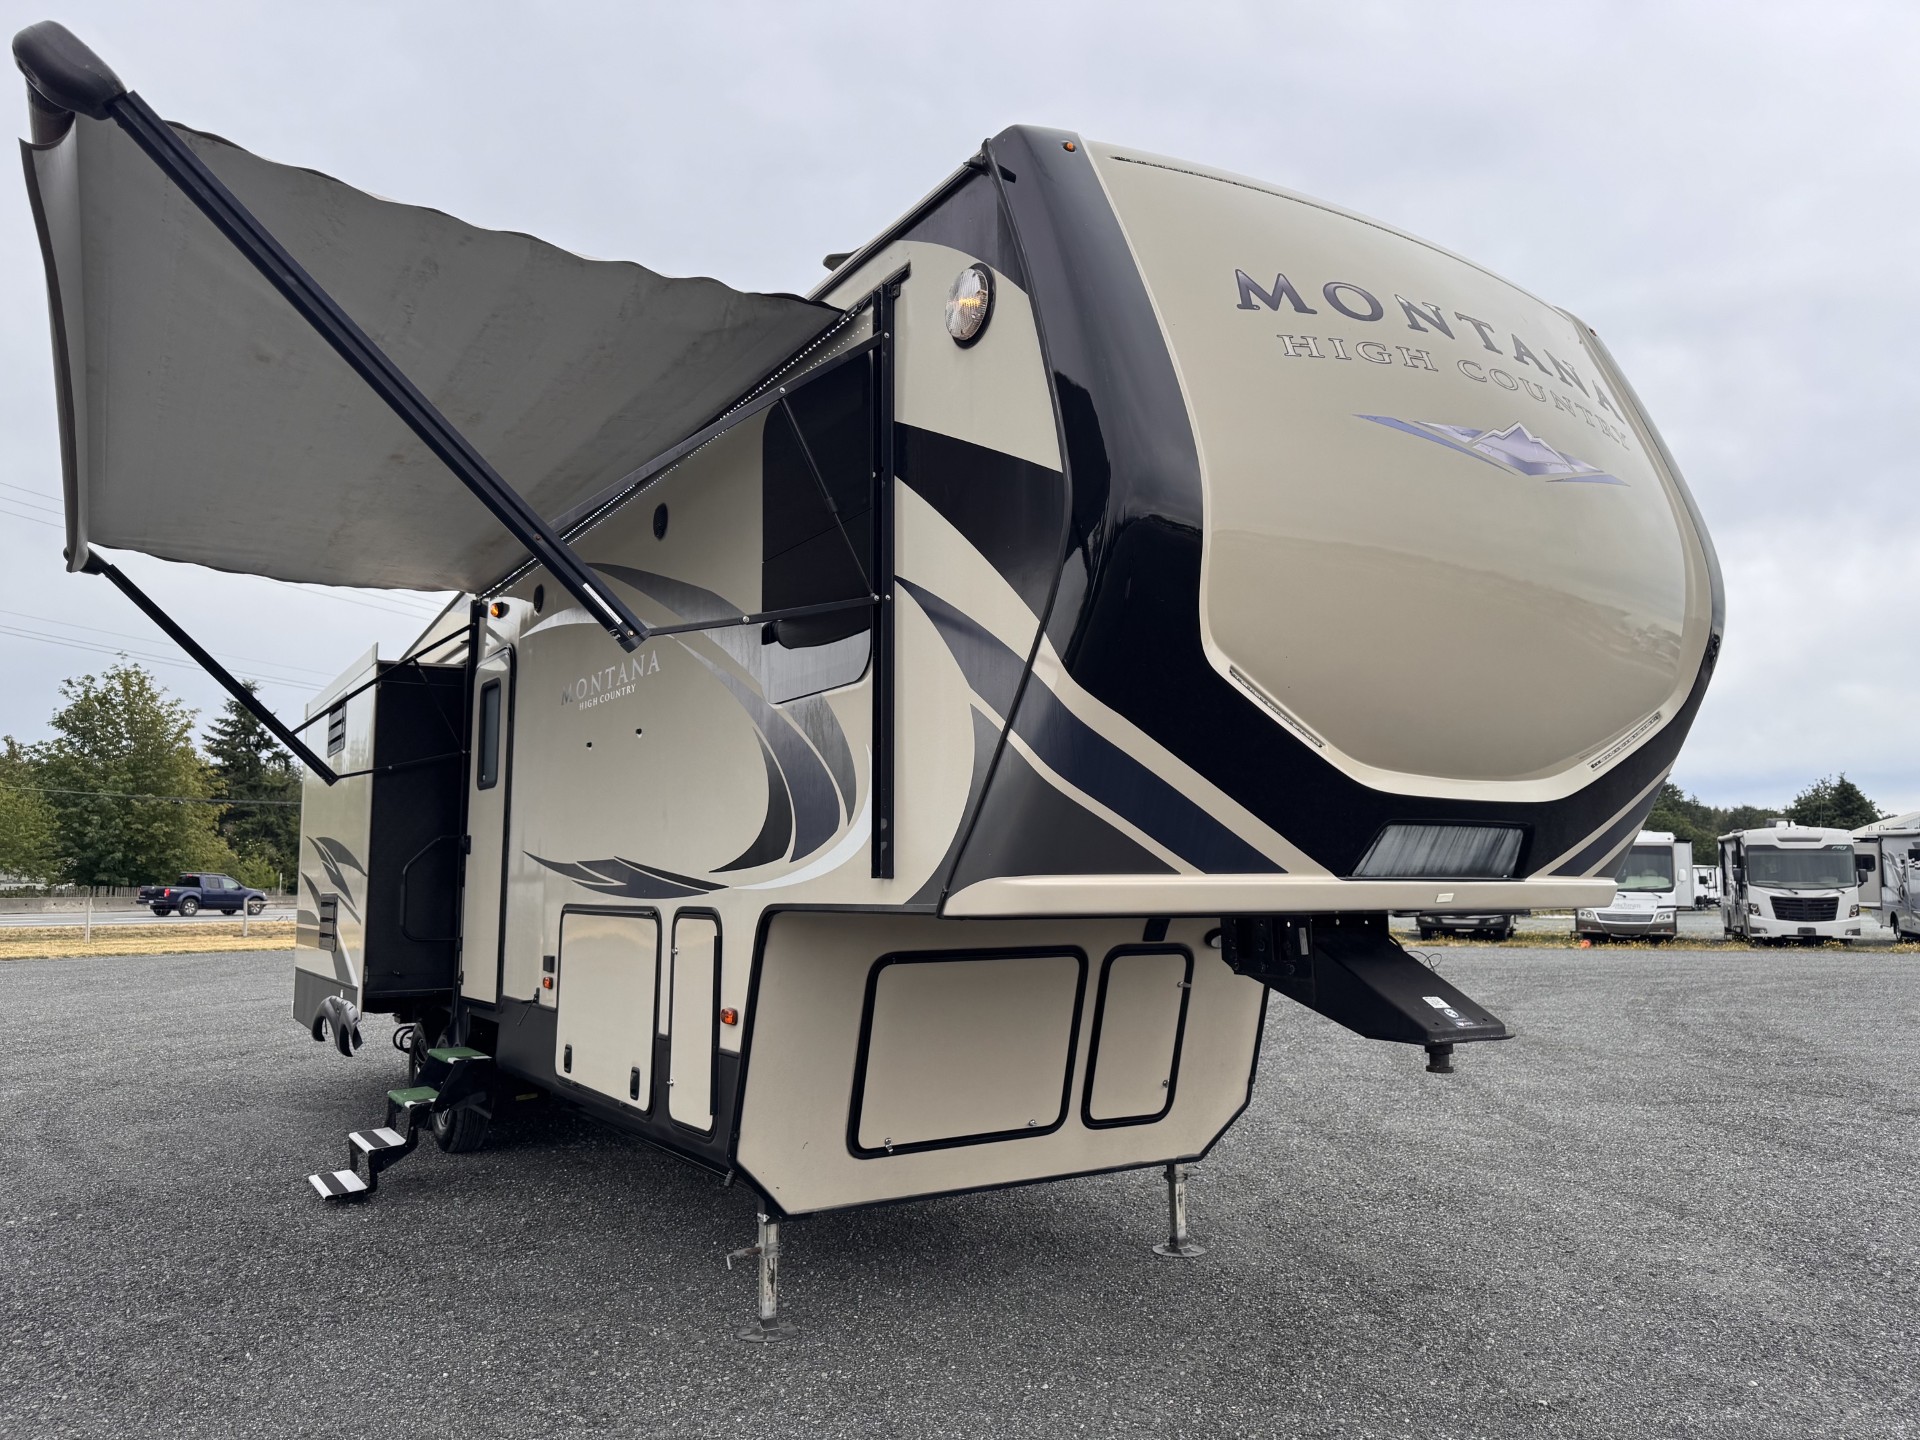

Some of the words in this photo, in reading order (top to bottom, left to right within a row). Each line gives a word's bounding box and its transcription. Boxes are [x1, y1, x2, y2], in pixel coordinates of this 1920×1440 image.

[1235, 268, 1625, 424] MONTANA
[1276, 334, 1439, 372] HIGH
[1457, 359, 1631, 451] COUNTRY
[561, 649, 661, 706] MONTANA
[579, 696, 598, 711] HIGH
[600, 683, 637, 704] COUNTRY
